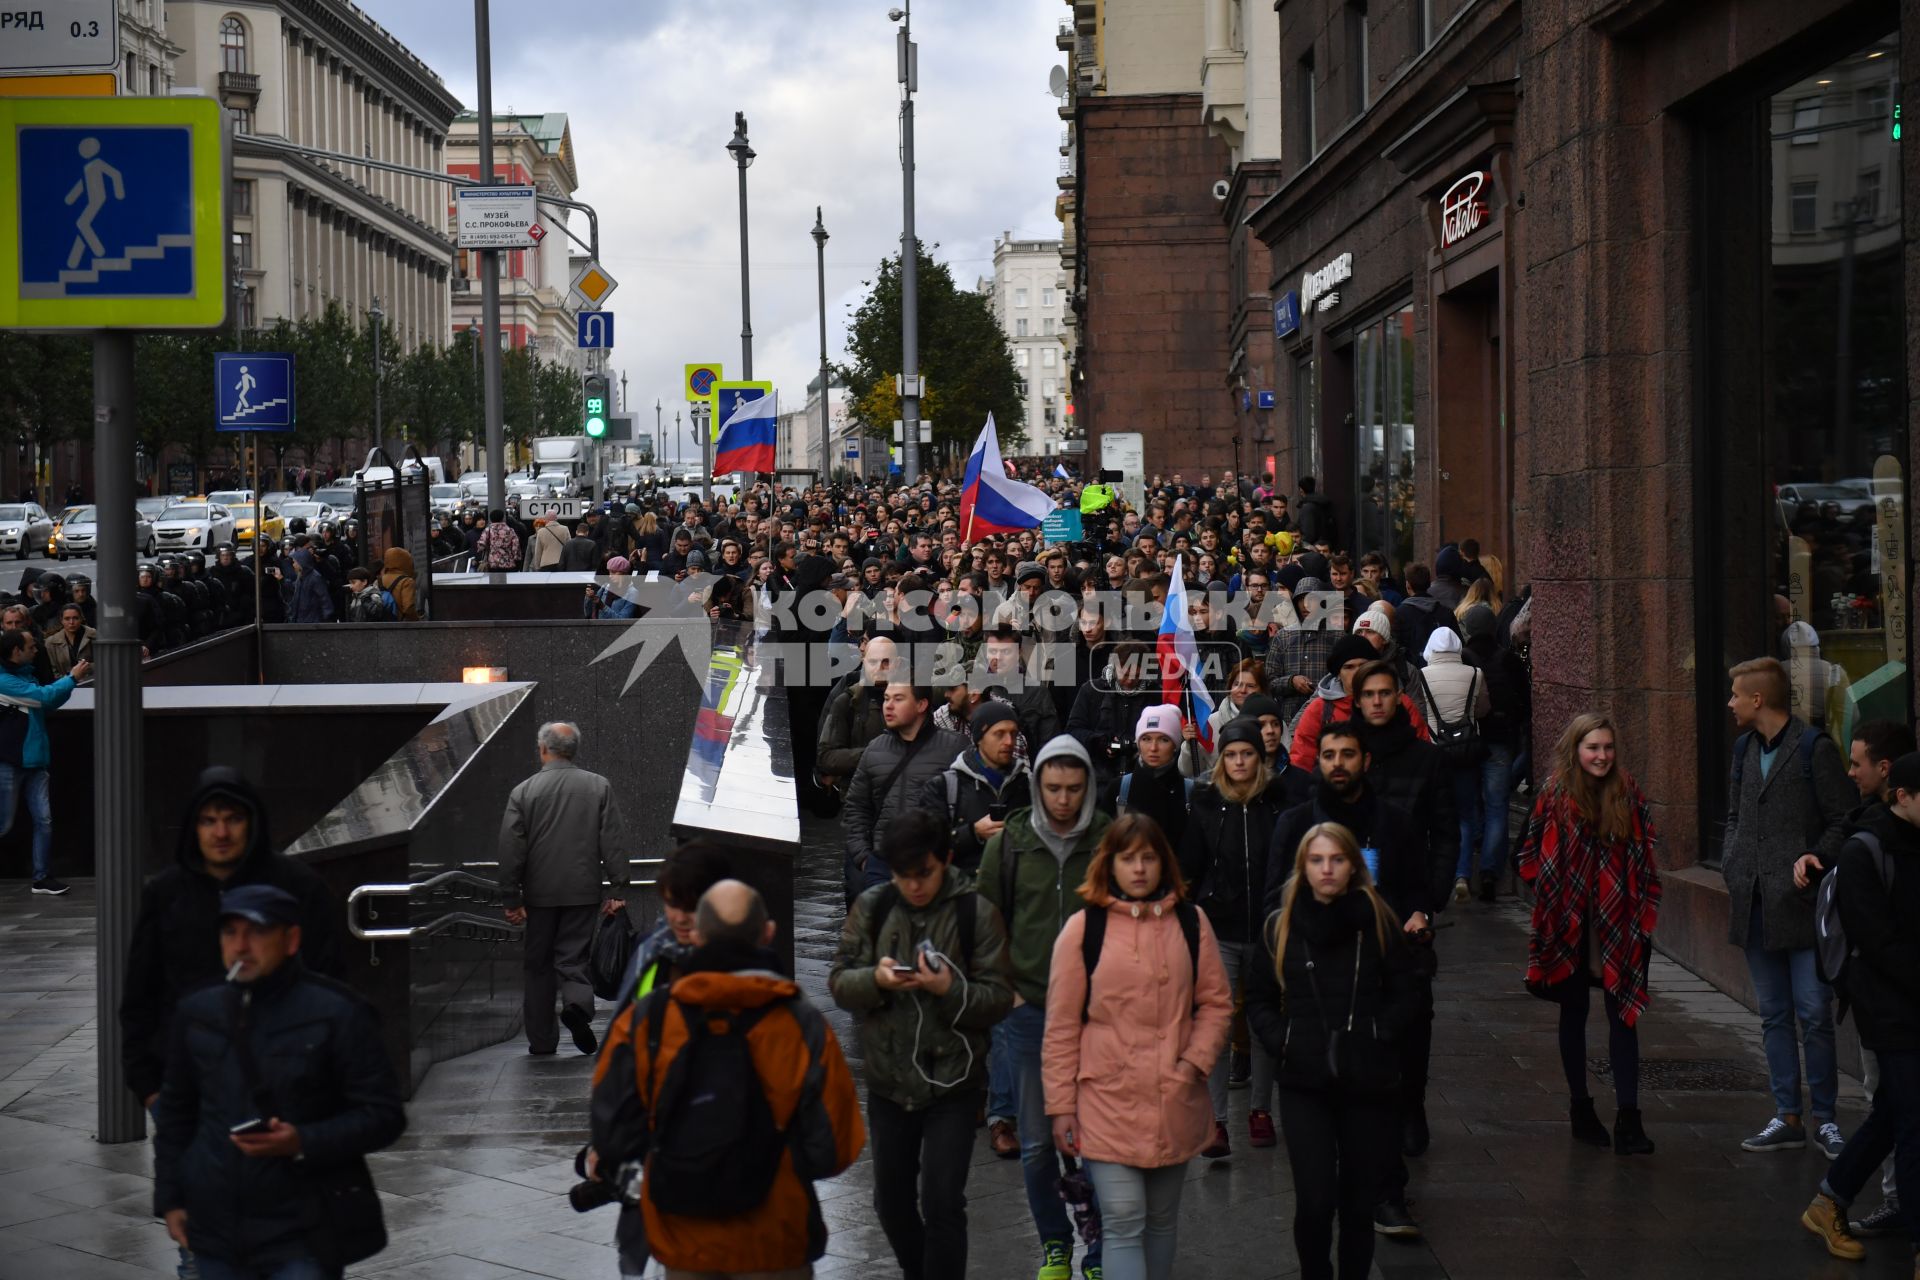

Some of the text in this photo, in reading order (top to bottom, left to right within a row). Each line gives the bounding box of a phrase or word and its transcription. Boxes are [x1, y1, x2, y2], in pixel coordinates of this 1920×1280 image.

[1, 11, 44, 31] РЯД
[70, 21, 99, 37] 0.3
[484, 211, 509, 219] МУЗЕЙ
[587, 398, 602, 414] 99
[529, 502, 573, 516] СТОП
